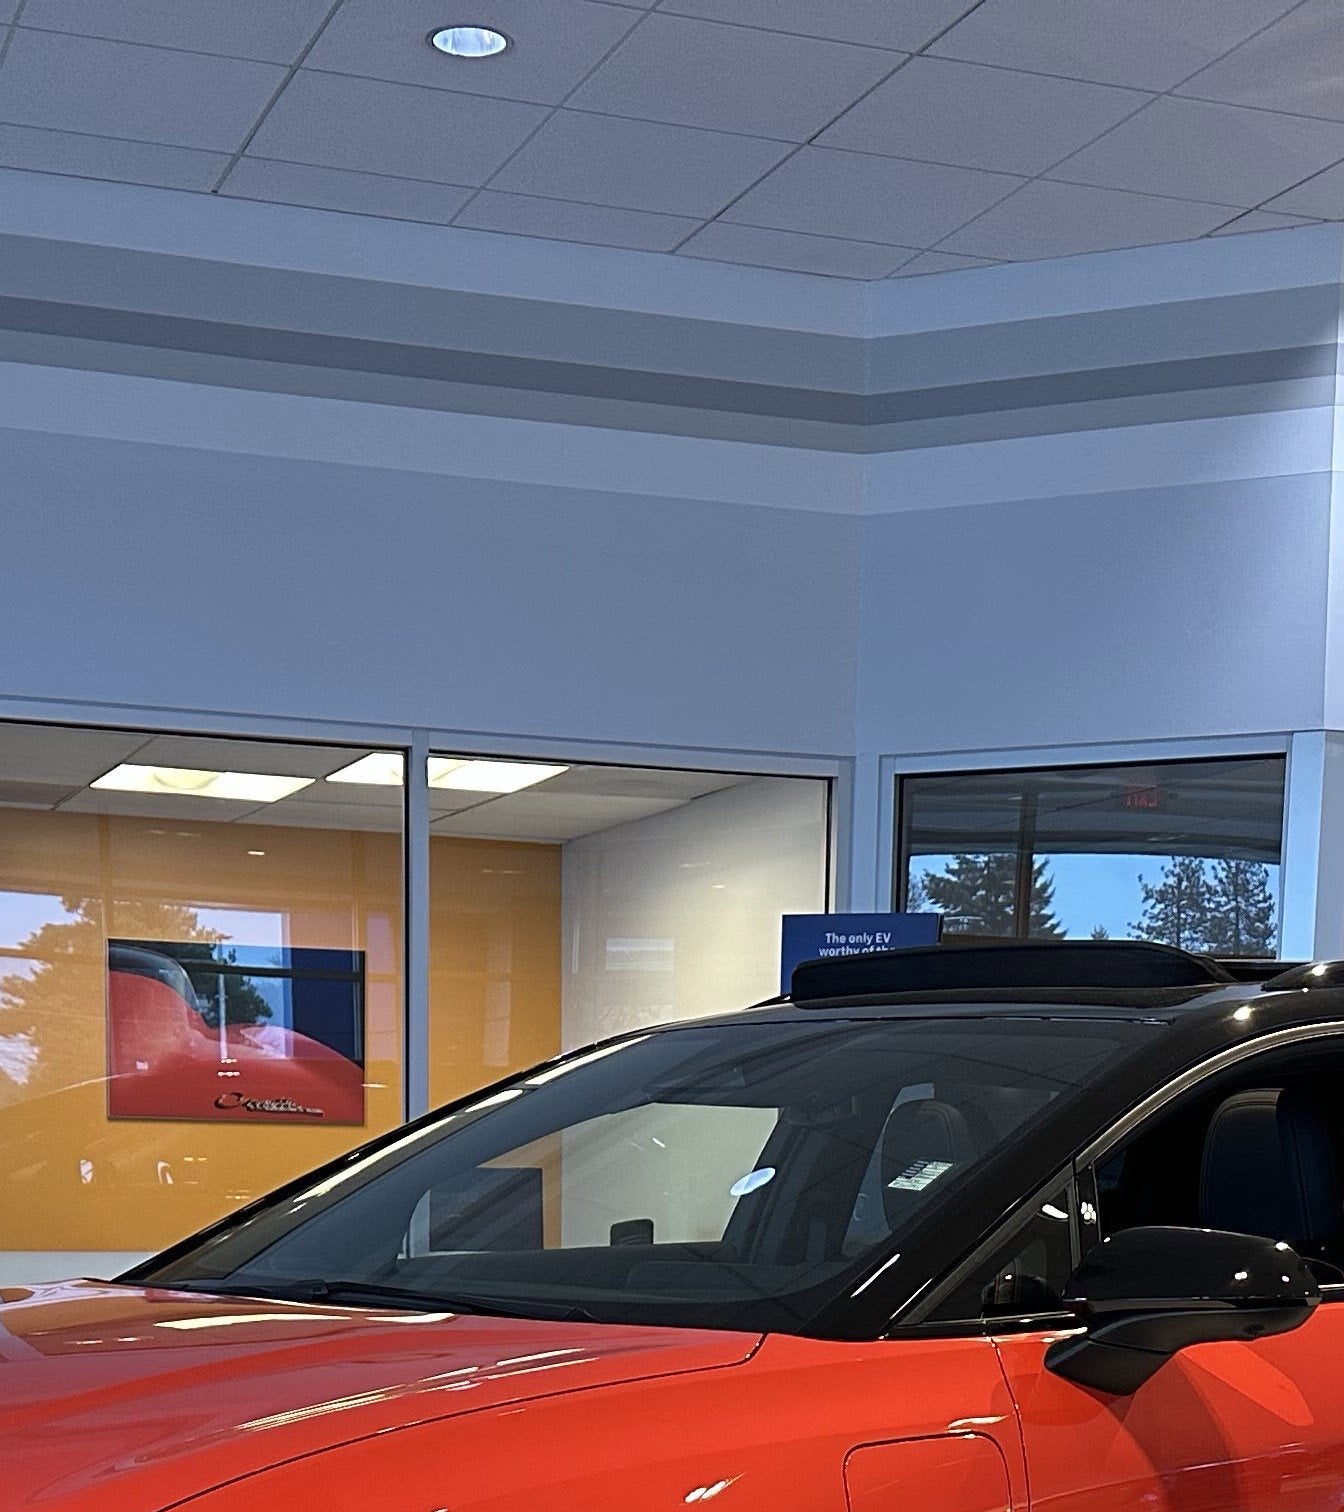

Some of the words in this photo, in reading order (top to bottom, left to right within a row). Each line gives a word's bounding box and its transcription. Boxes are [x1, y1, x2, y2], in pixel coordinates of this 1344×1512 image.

[825, 932, 847, 944] The
[848, 932, 874, 946] only
[875, 932, 892, 944] EV
[818, 945, 860, 957] worthy
